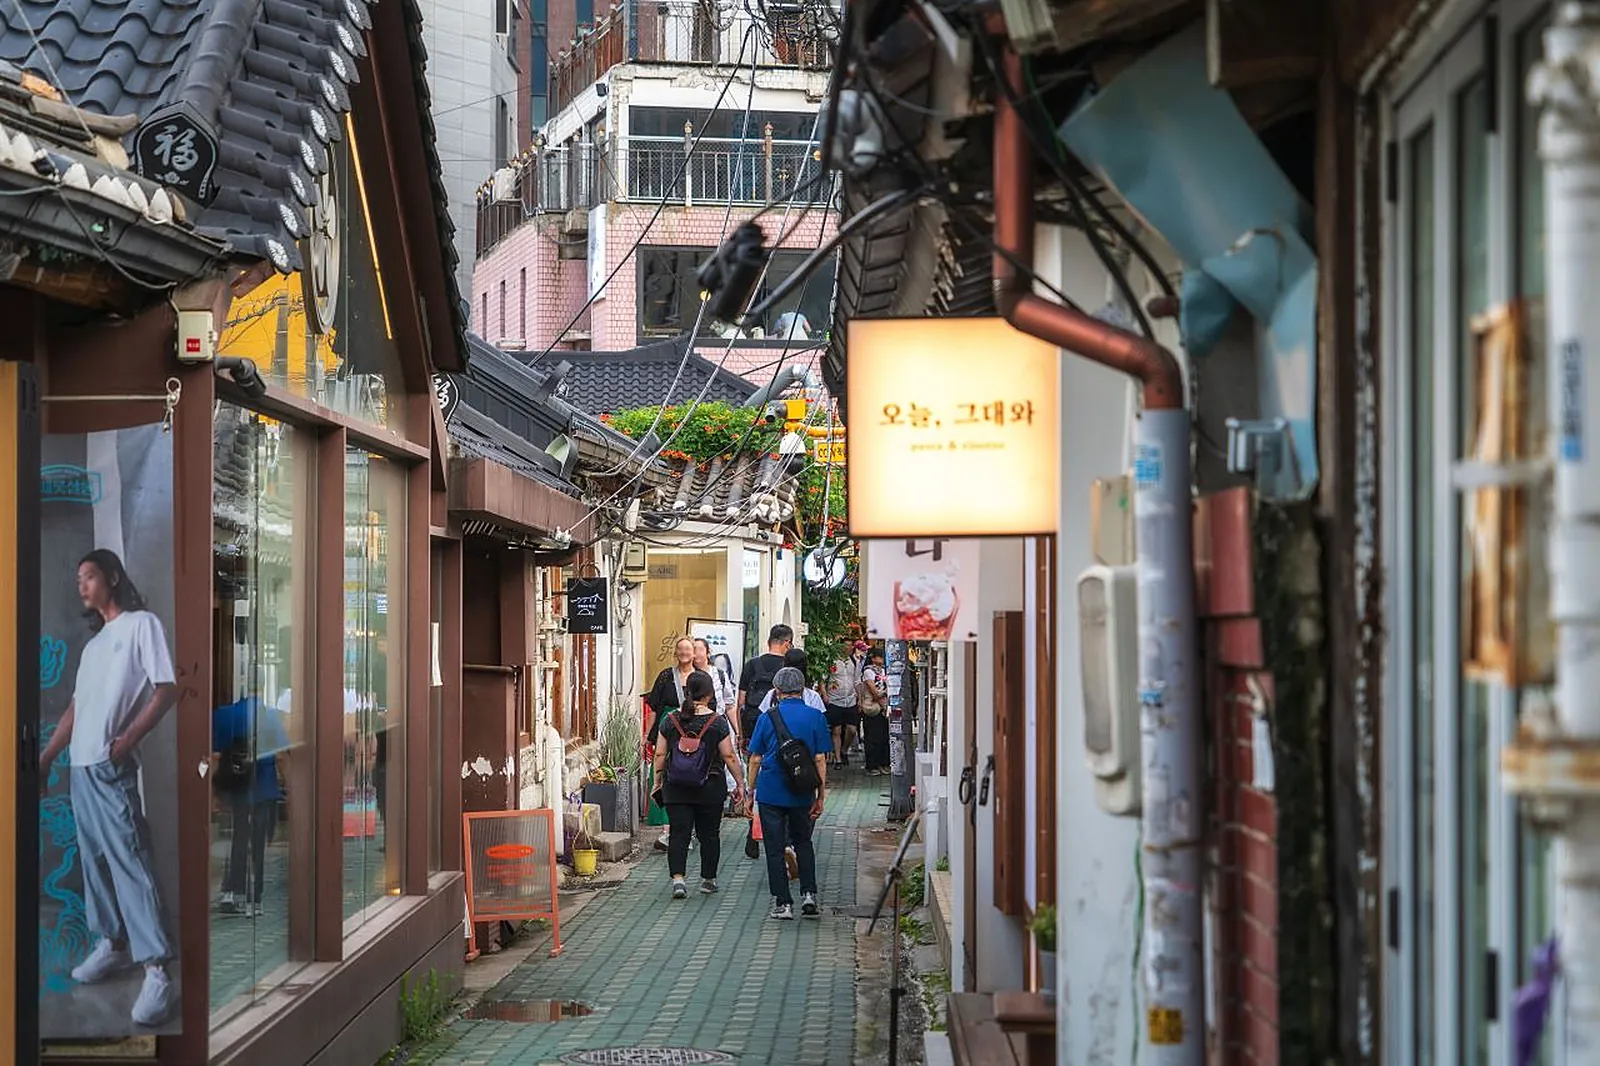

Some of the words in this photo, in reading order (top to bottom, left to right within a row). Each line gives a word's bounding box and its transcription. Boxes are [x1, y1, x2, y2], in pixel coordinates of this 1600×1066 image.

[153, 124, 199, 171] 福
[879, 402, 941, 428] 오늘,
[954, 400, 1034, 427] 그대와
